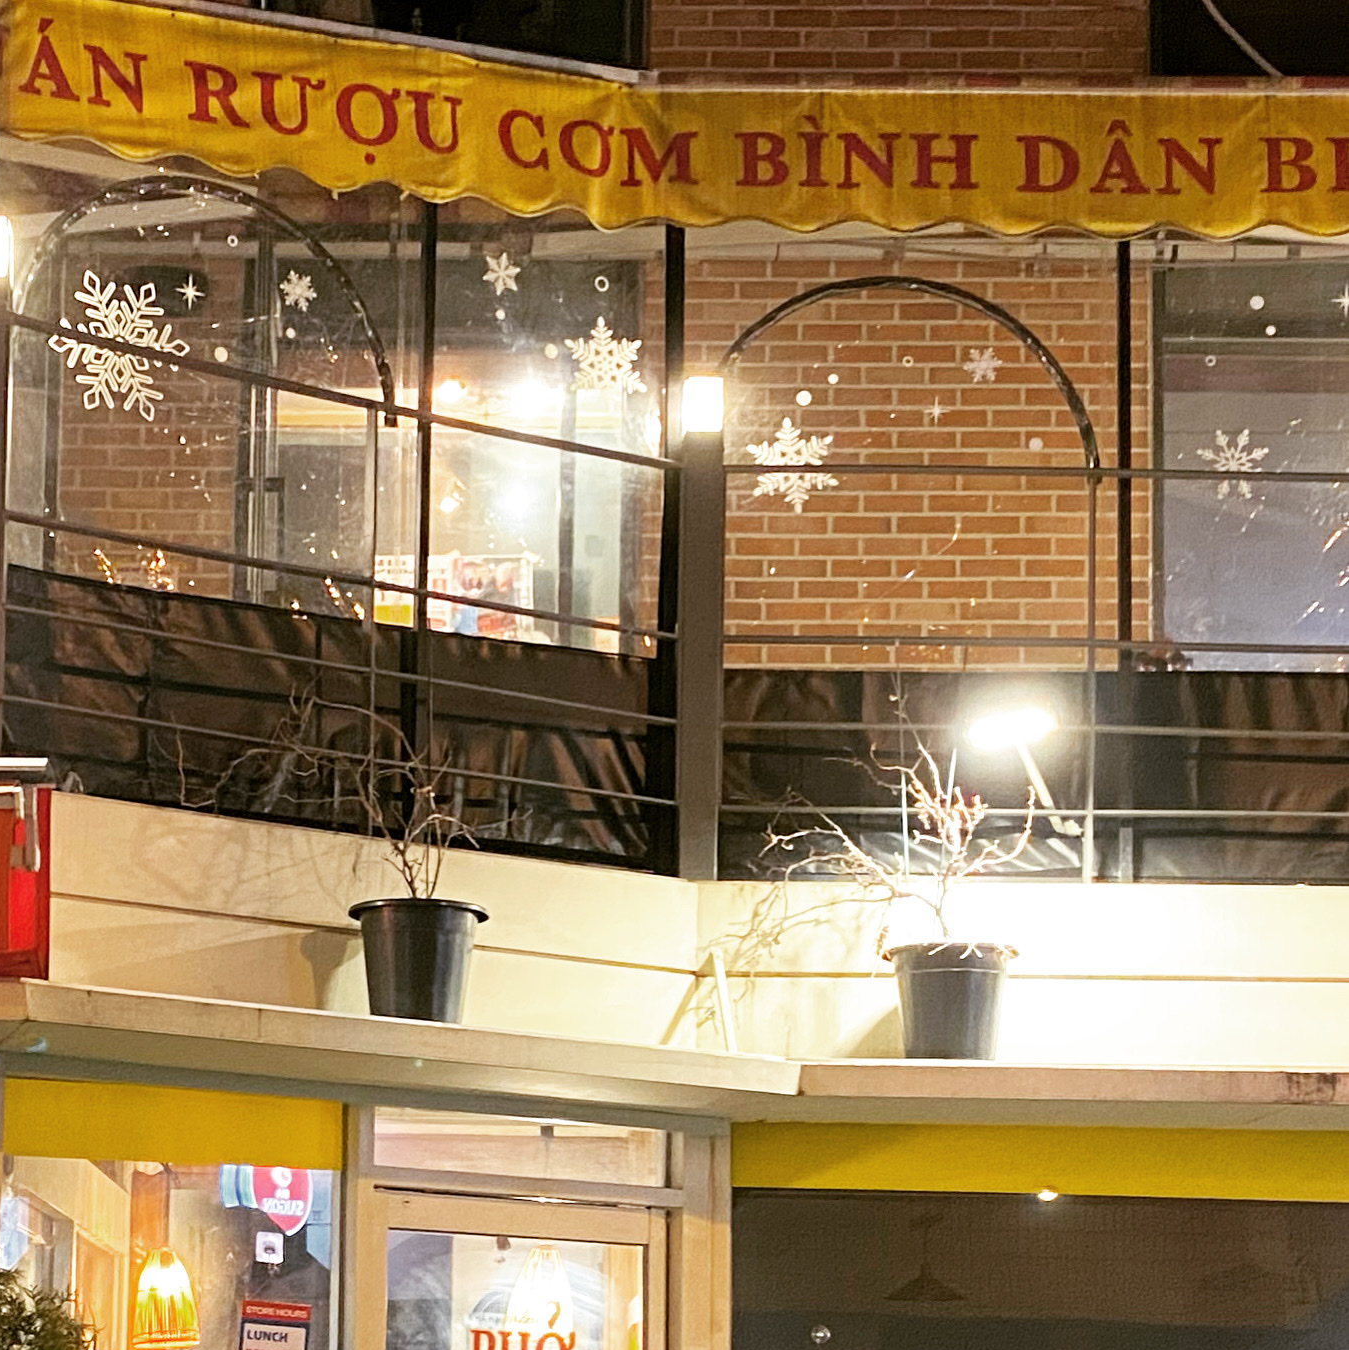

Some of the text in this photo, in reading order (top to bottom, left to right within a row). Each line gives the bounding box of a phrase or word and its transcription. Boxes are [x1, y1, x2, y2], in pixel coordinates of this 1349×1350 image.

[735, 115, 979, 191] BÌNH
[1016, 119, 1222, 196] DÂN
[246, 1329, 288, 1343] LUNCH
